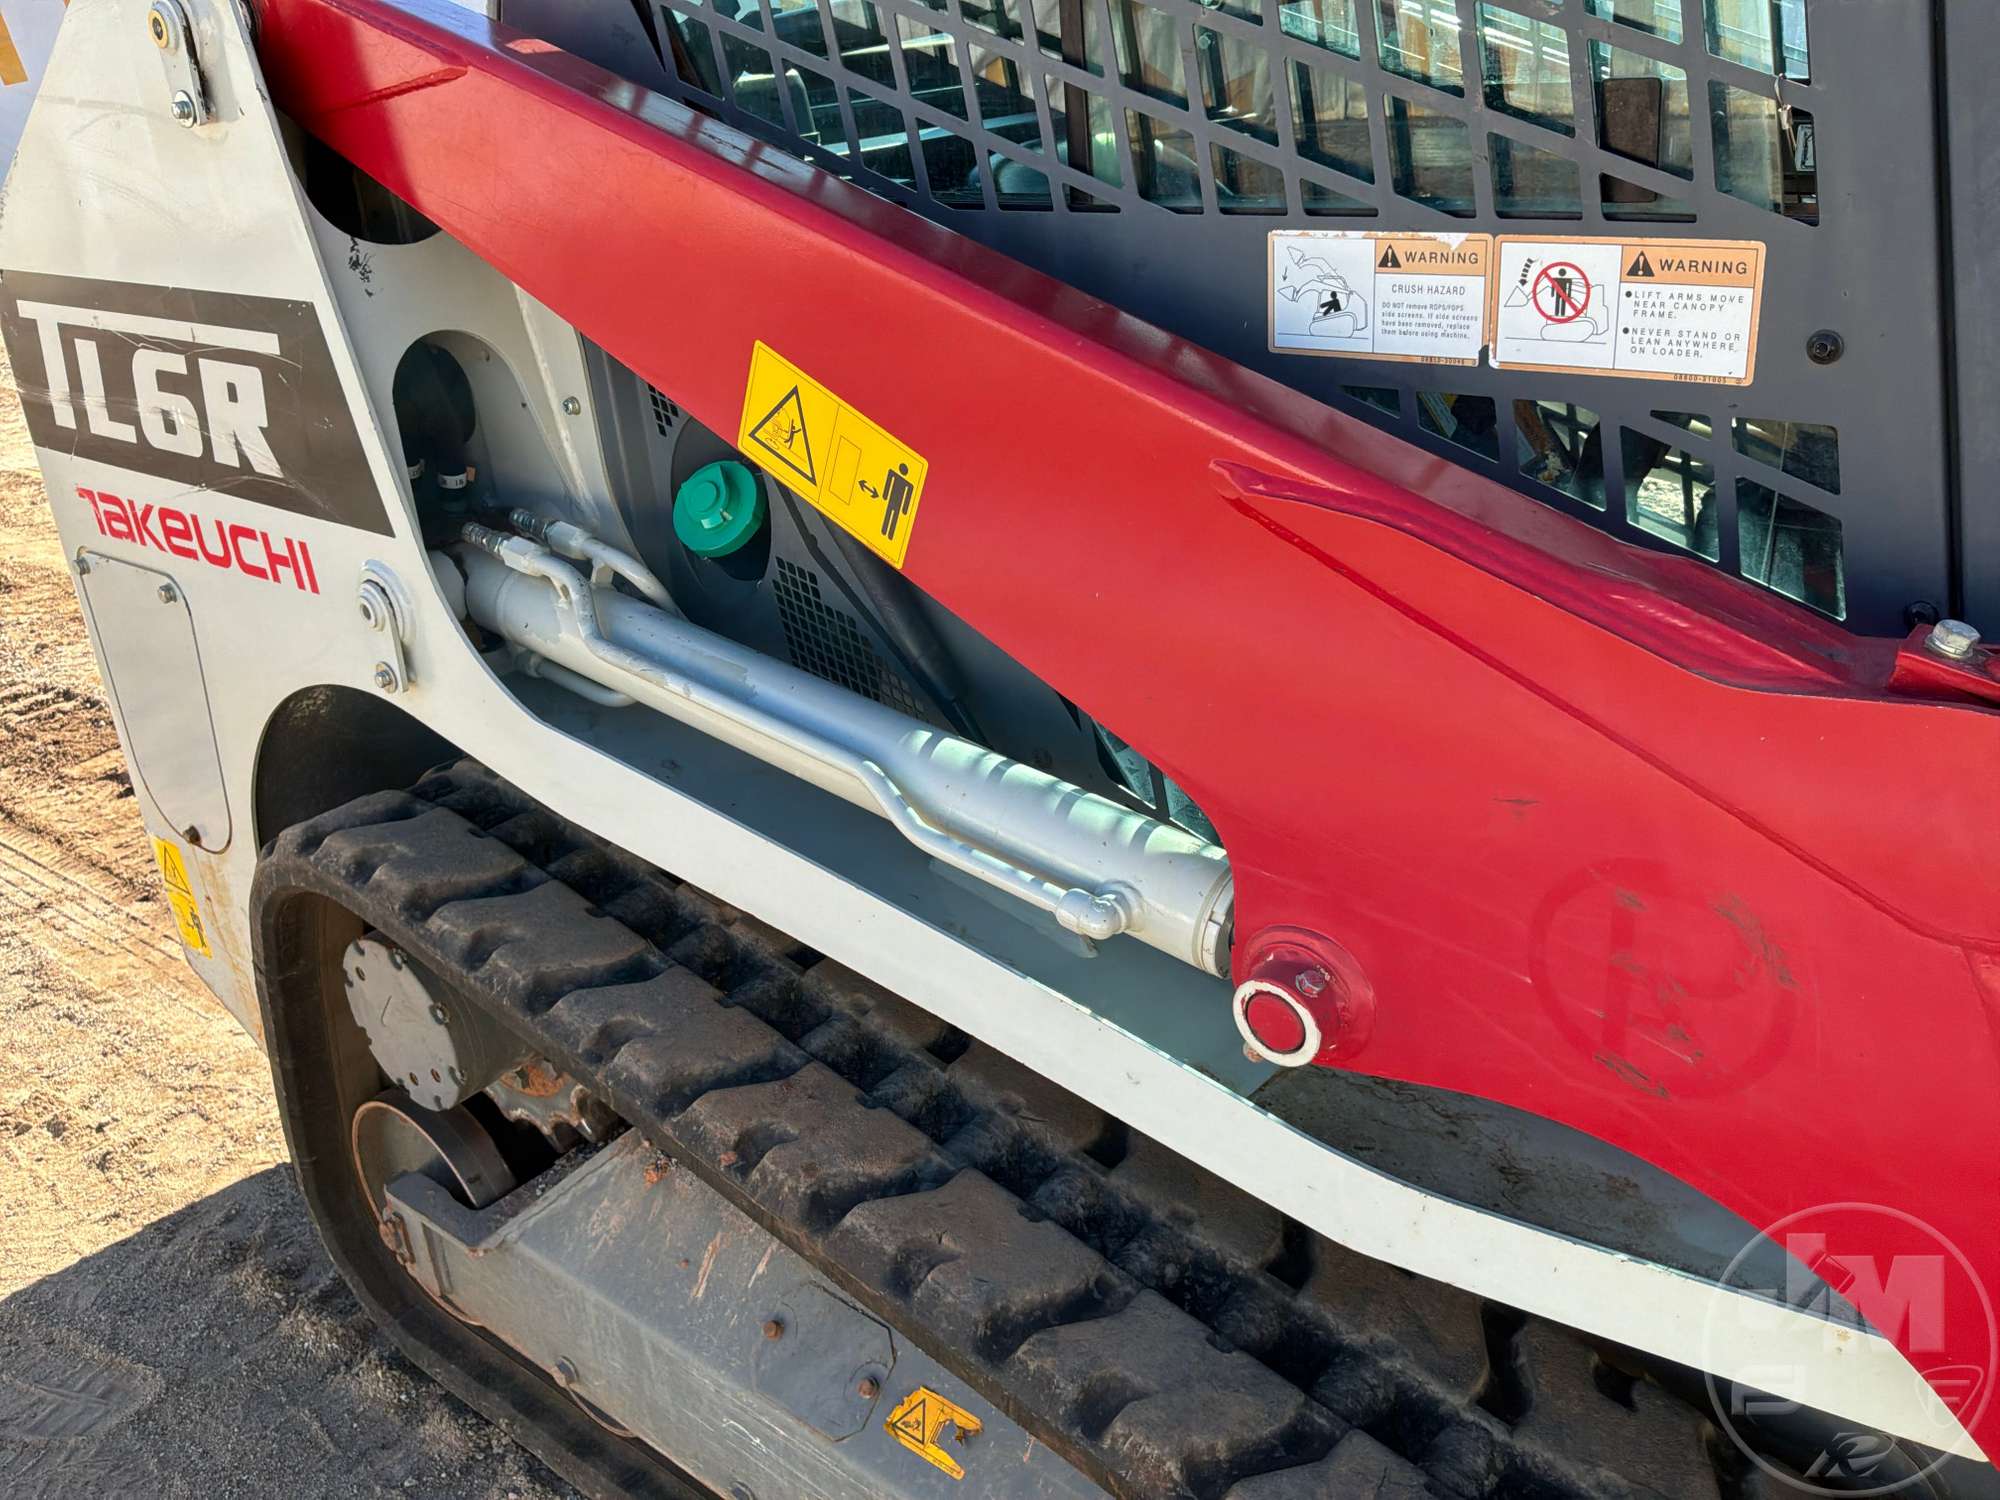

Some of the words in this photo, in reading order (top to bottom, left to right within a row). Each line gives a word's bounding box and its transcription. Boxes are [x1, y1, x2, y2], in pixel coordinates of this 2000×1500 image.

[1405, 251, 1478, 264] WARNING
[1659, 259, 1747, 275] WARNING
[1392, 284, 1423, 294] CRUSH
[1427, 286, 1466, 295] HAZARD
[1669, 293, 1702, 301] ARMS
[1711, 295, 1745, 304] MOVE
[1674, 302, 1725, 312] CANOPY
[1633, 310, 1677, 319] FRAME.
[1441, 331, 1470, 339] machine.
[1632, 328, 1670, 336] NEVER
[1678, 330, 1718, 340] STAND
[1725, 333, 1741, 341] OR
[1631, 337, 1661, 346] LEAN
[1668, 339, 1735, 351] ANYWHERE
[1630, 346, 1646, 354] ON
[1652, 347, 1703, 358] LOADER.
[16, 299, 285, 478] TL6R
